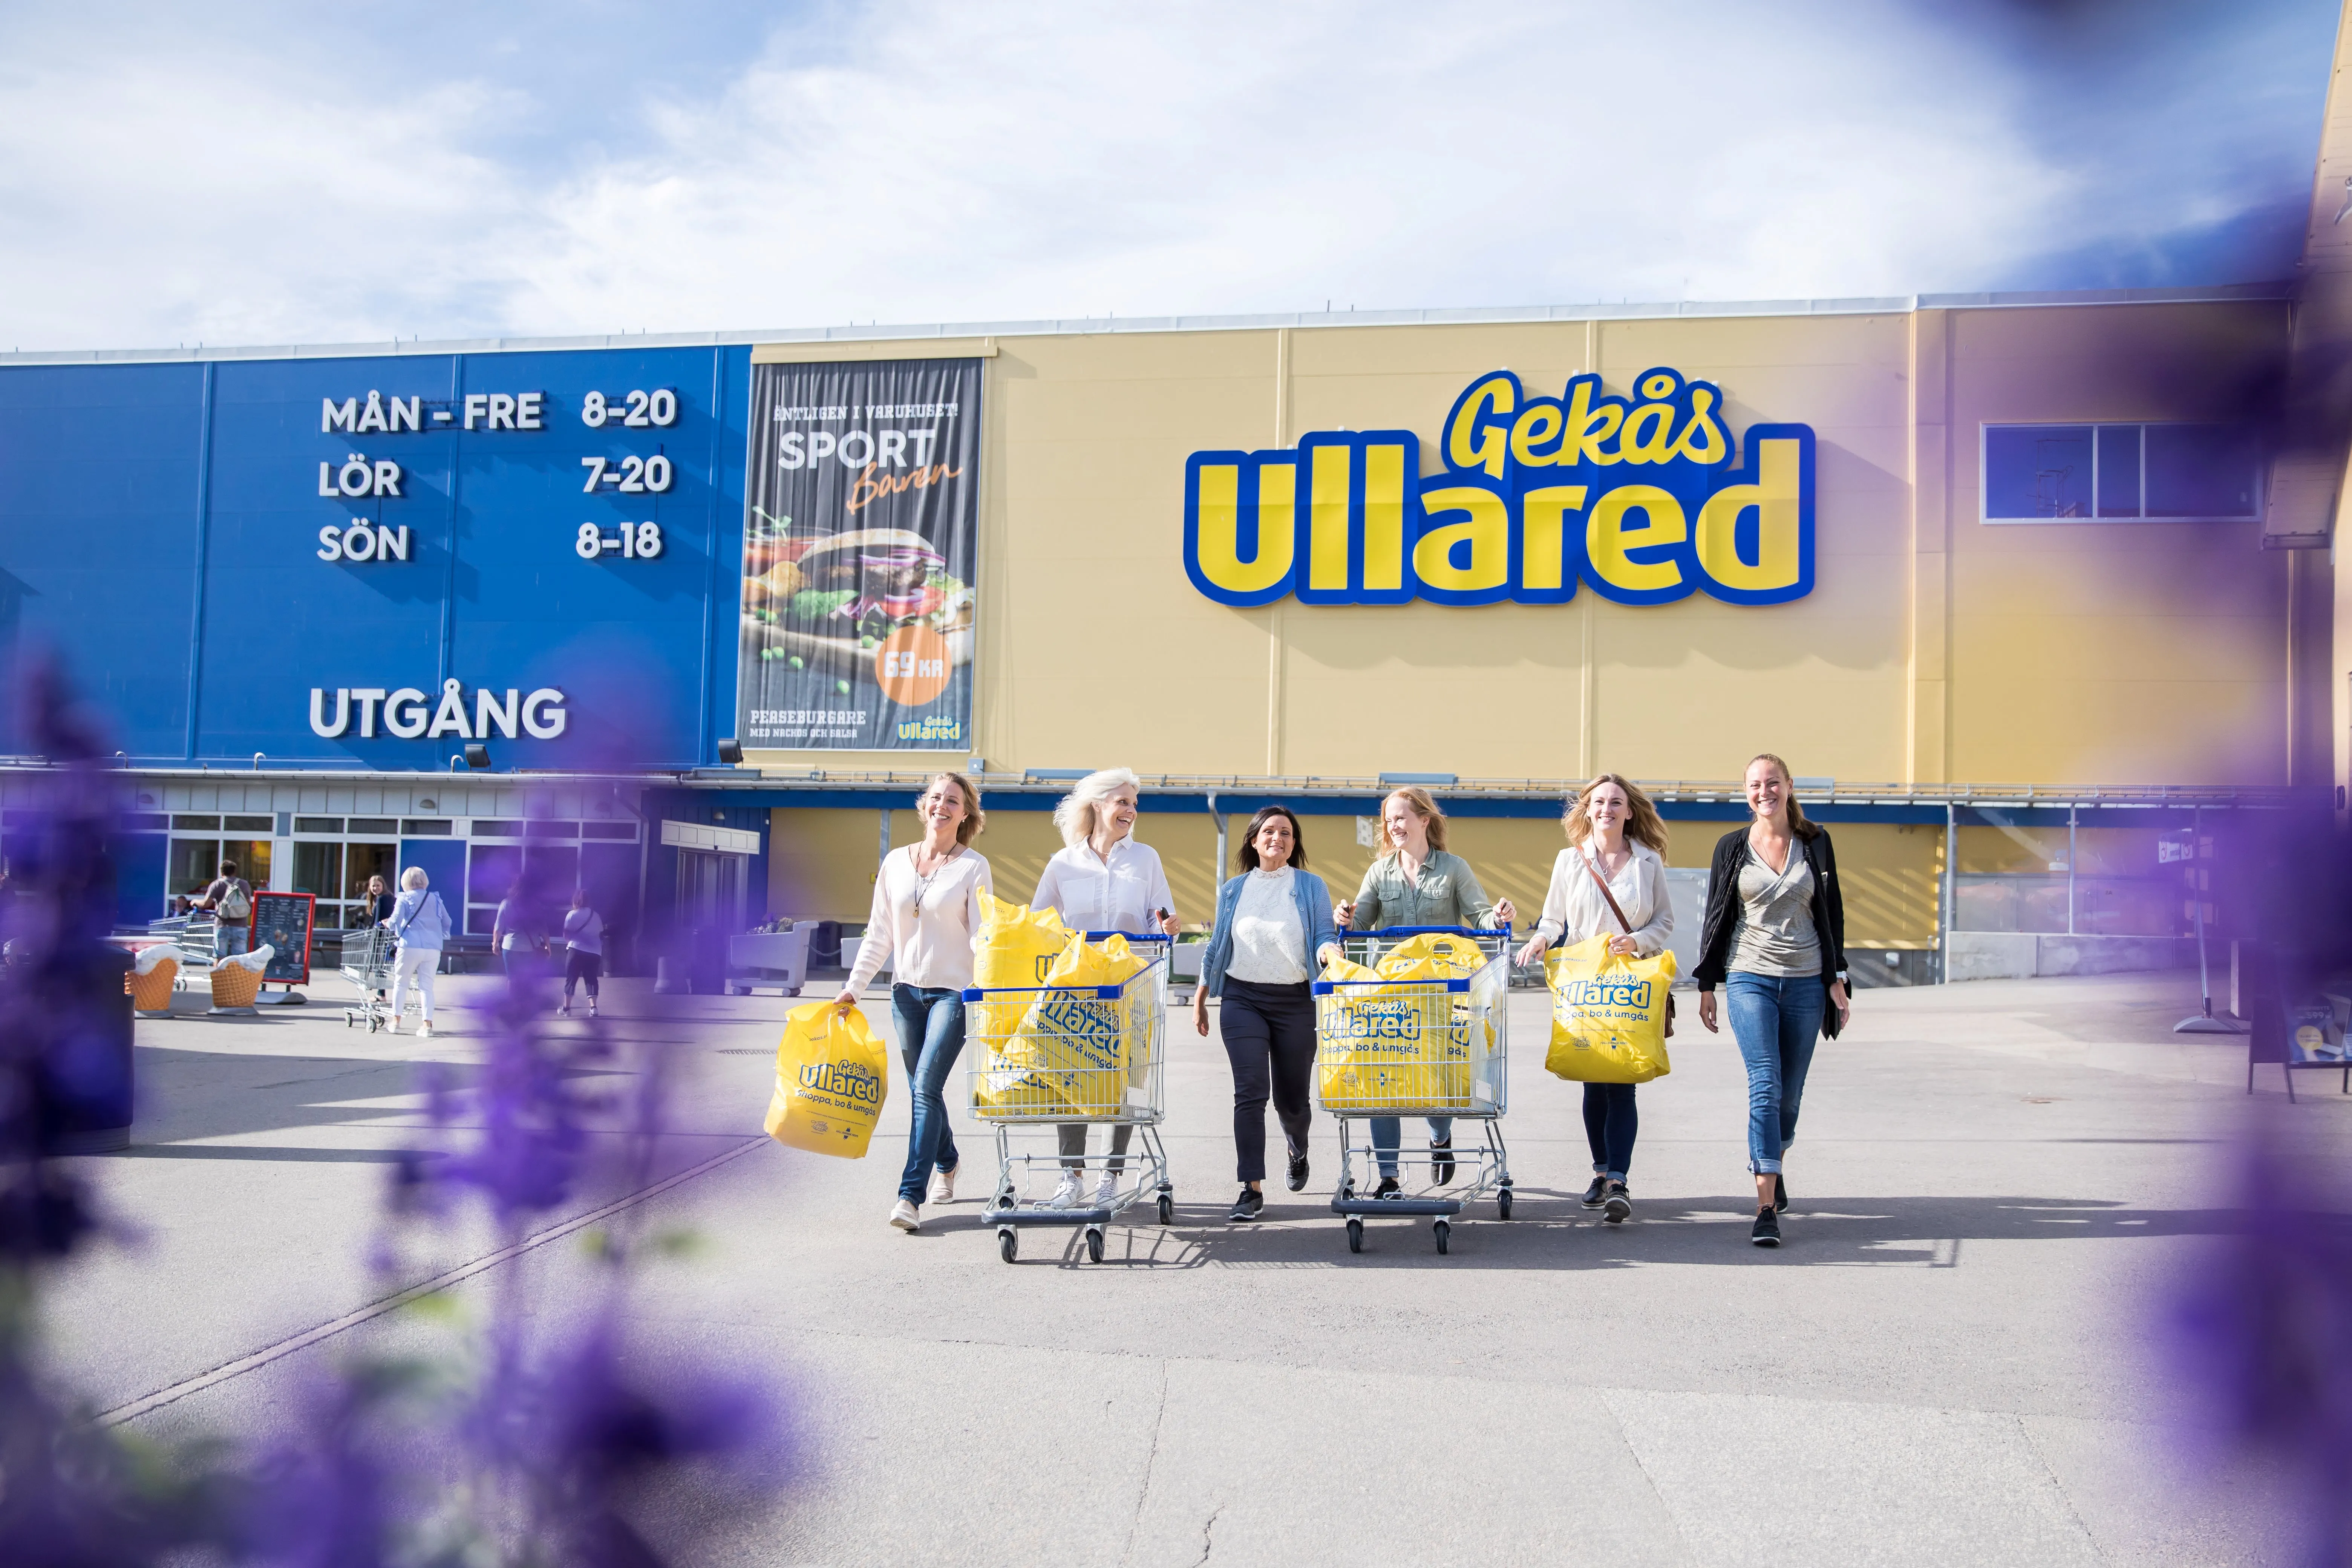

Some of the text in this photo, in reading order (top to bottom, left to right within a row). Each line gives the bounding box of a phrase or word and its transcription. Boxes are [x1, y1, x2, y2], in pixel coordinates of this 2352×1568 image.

[322, 389, 421, 433] MÅN
[464, 392, 542, 430] FRE
[582, 389, 677, 428] 8-20
[853, 406, 860, 420] I
[865, 403, 959, 420] VARUHUSET!
[1449, 372, 1727, 481] Gekås
[778, 429, 936, 470] SPORT
[318, 453, 672, 497] LÖR 7-20
[846, 461, 963, 516] Baren
[317, 518, 662, 562] SÖN 8-18
[884, 651, 944, 678] 69 KR
[309, 678, 567, 739] UTGÅNG
[750, 728, 858, 738] MED NACHOS OCH SALSA
[1614, 1011, 1649, 1021] umgås
[1075, 1043, 1083, 1054] &
[1355, 1043, 1369, 1051] bo
[1372, 1042, 1380, 1051] &
[1382, 1043, 1419, 1055] umgås
[1447, 1047, 1467, 1058] gås
[835, 1098, 845, 1108] bo
[846, 1101, 852, 1110] &
[853, 1104, 876, 1116] umgås
